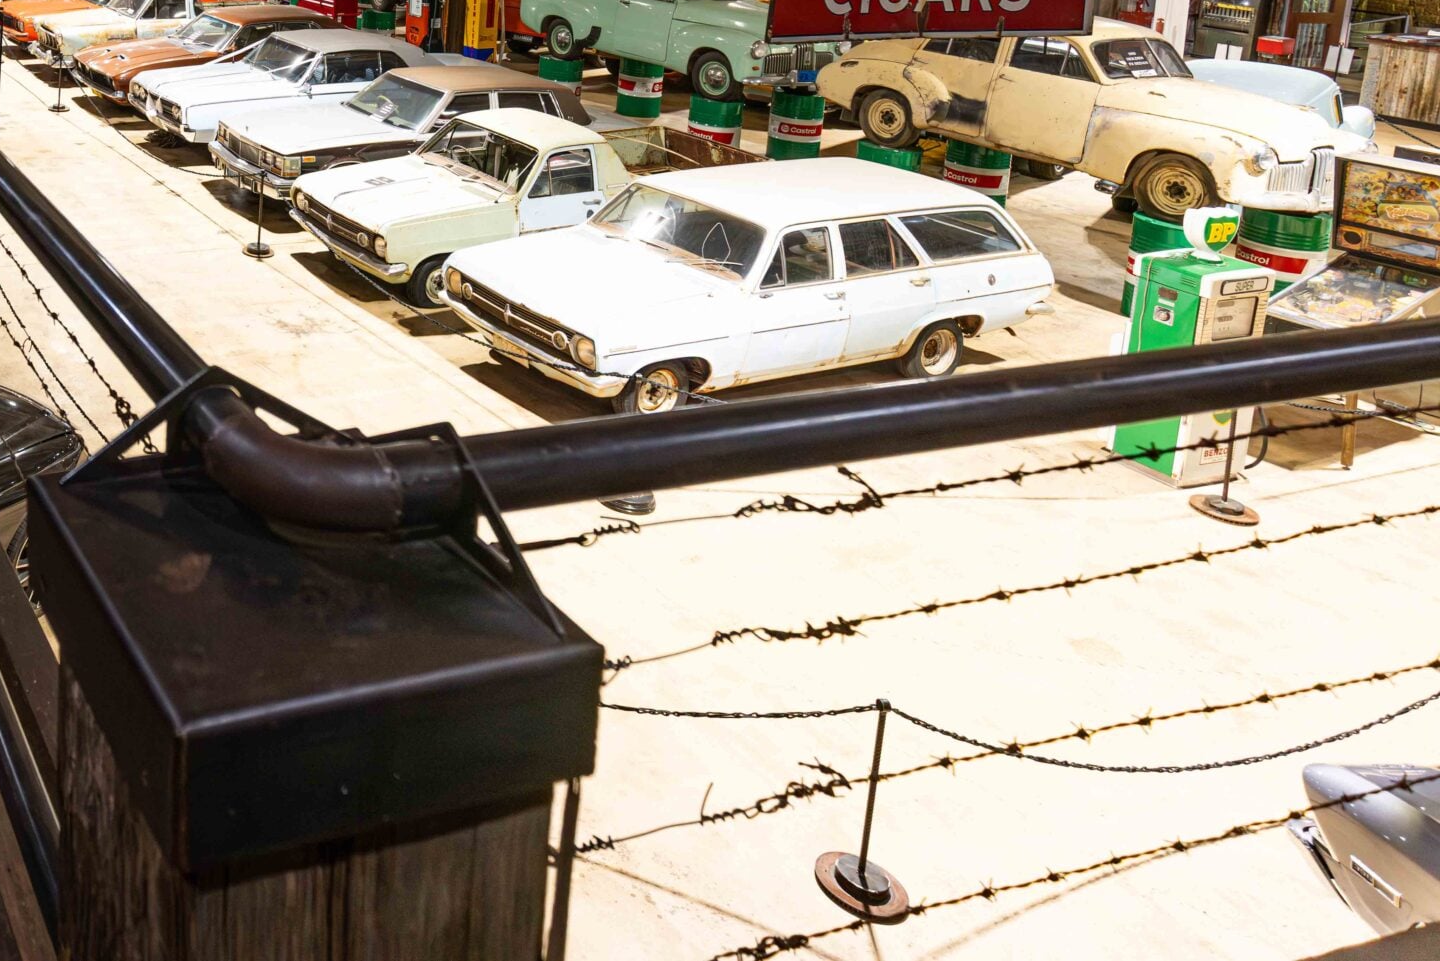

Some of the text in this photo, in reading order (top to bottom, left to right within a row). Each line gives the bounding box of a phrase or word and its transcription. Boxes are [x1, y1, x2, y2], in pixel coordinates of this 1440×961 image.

[790, 126, 817, 134] Castrol
[948, 171, 977, 183] Castrol
[1207, 222, 1237, 243] BP
[1237, 249, 1270, 265] Castrol
[1235, 281, 1254, 292] SUPER
